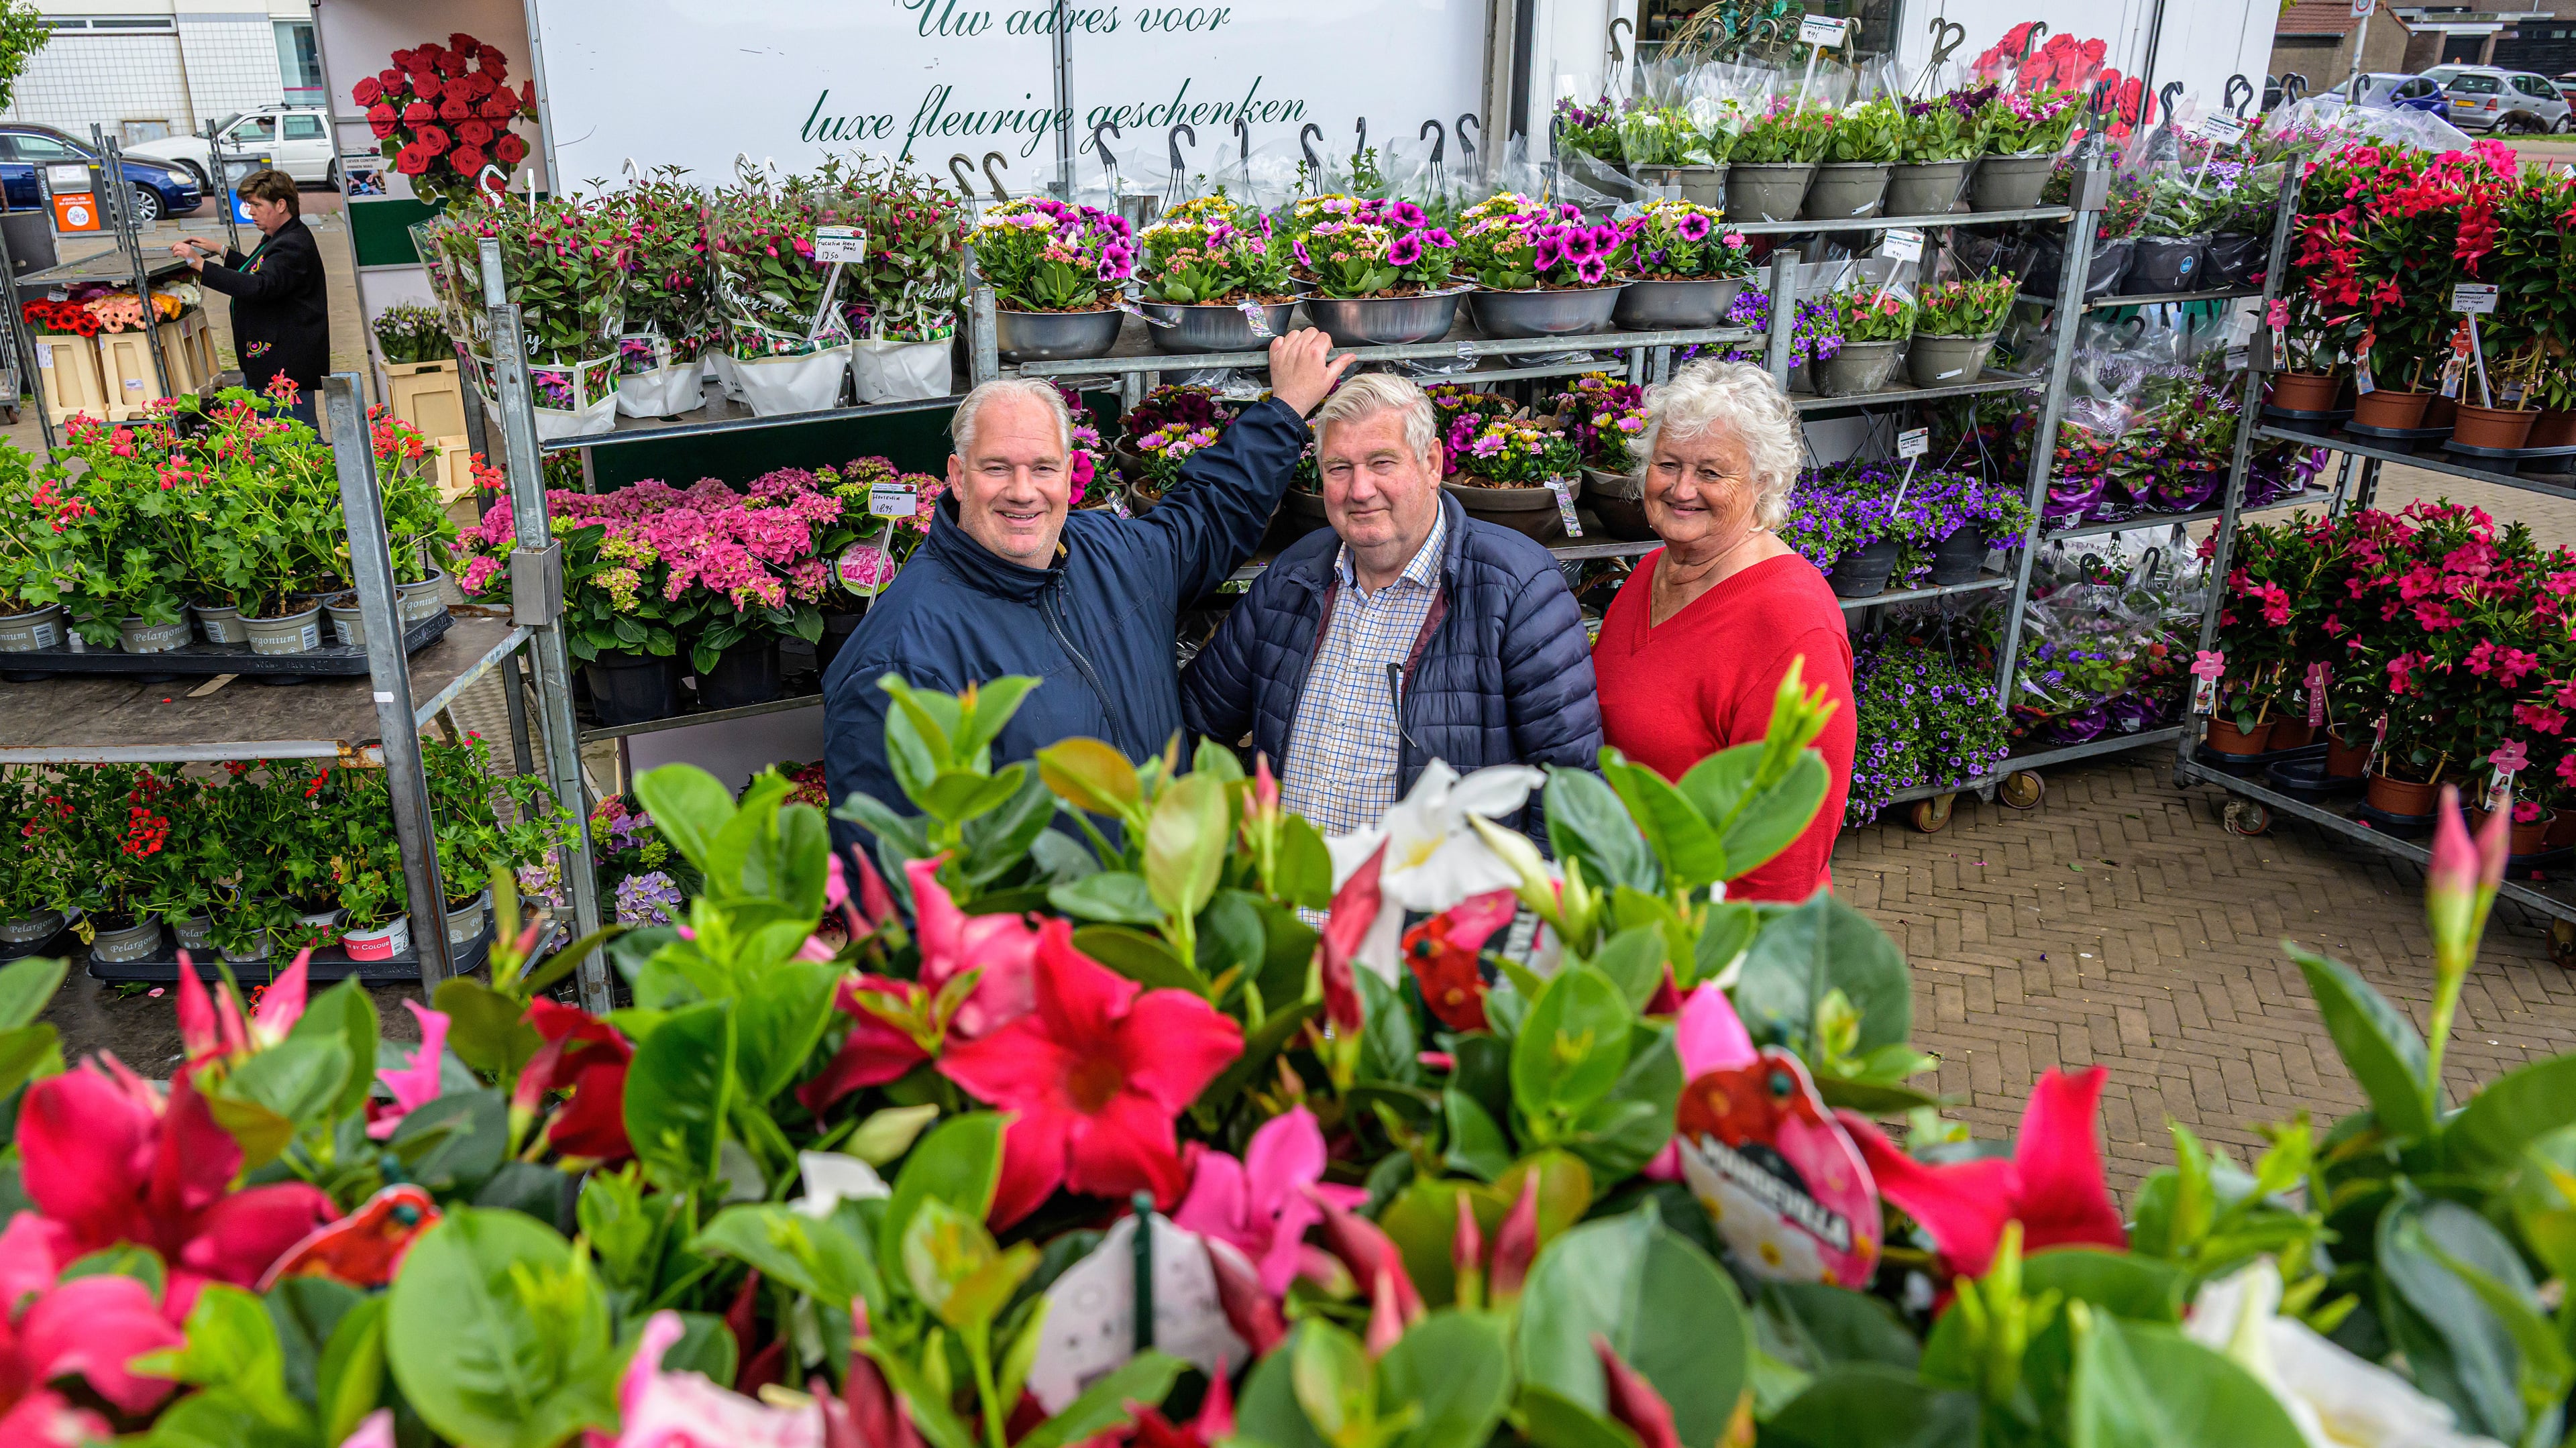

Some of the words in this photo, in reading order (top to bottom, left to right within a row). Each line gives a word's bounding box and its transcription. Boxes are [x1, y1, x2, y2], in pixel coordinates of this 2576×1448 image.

[895, 0, 993, 37] Uw
[1006, 0, 1122, 35] adres
[1134, 7, 1230, 32] voor
[801, 89, 895, 143] luxe
[898, 84, 1073, 161] fleurige
[1079, 76, 1307, 154] geschenken
[845, 577, 874, 588] HYDRANG
